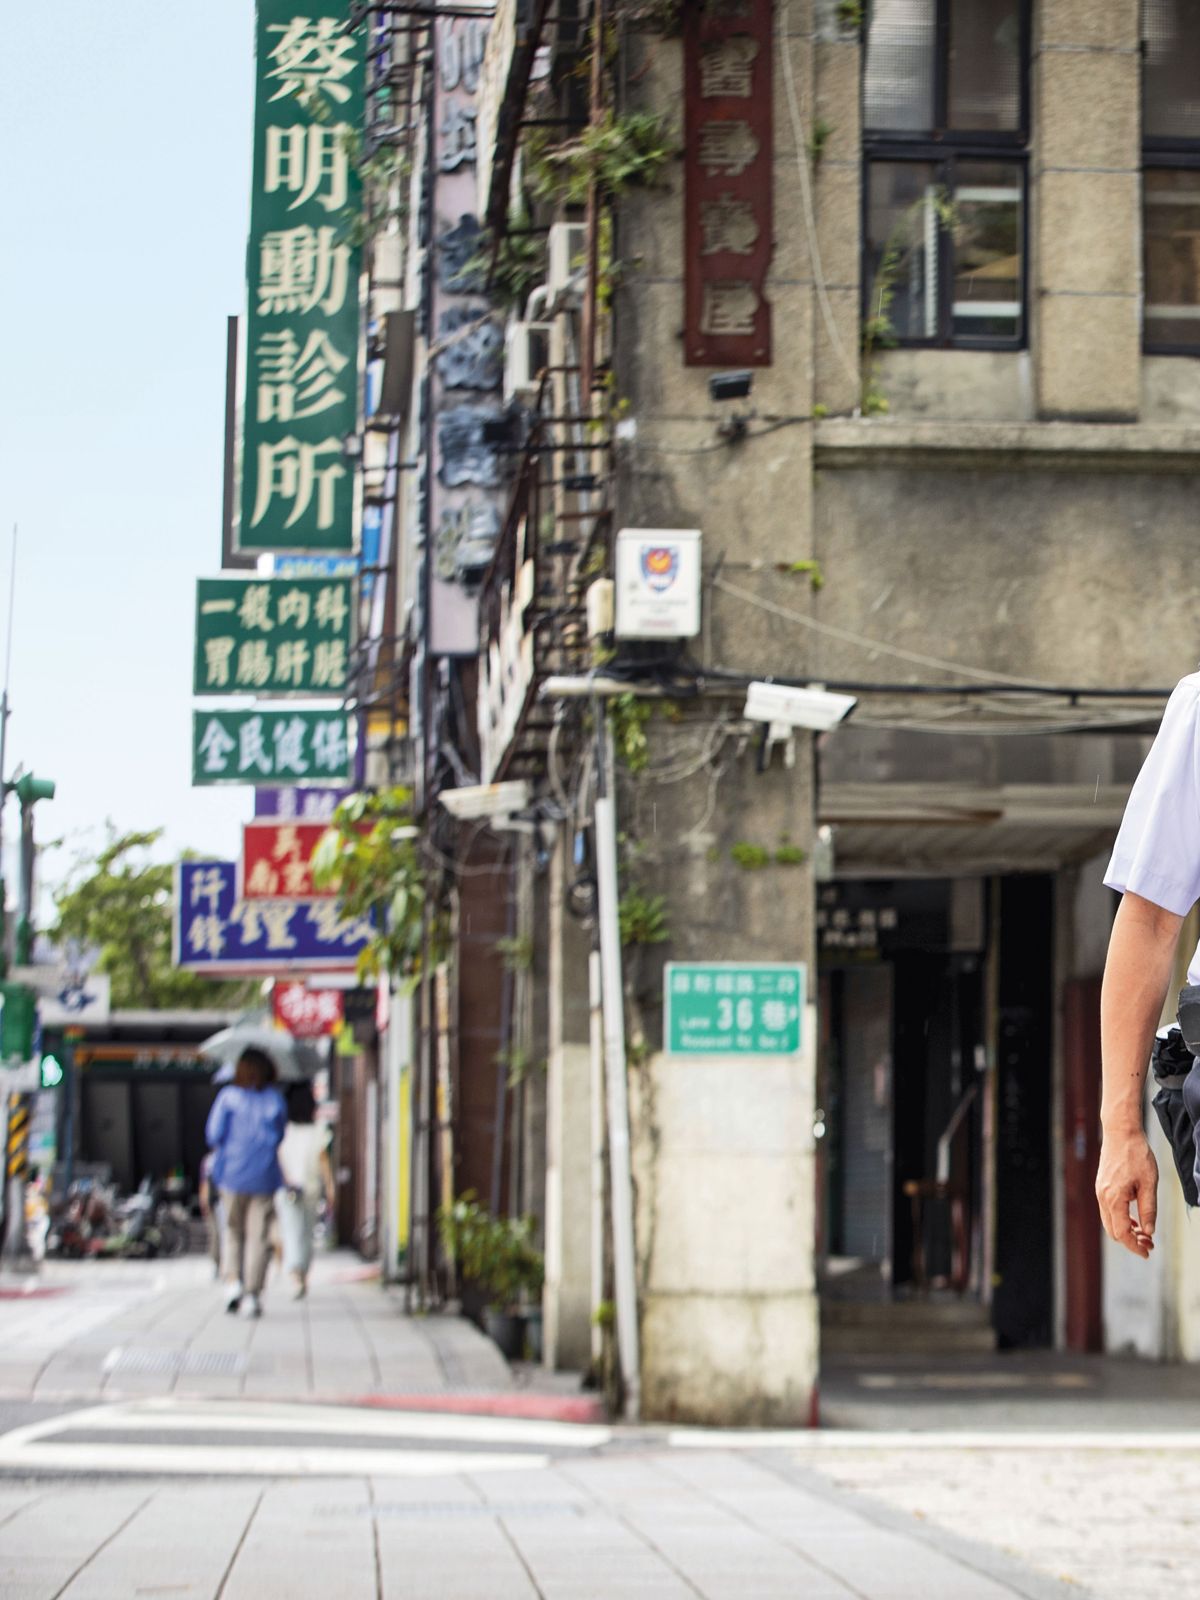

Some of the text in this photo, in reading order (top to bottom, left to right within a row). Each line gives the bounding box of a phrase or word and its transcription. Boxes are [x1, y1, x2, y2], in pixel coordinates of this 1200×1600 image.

[199, 715, 348, 775] 全民健保
[716, 997, 754, 1031] 36
